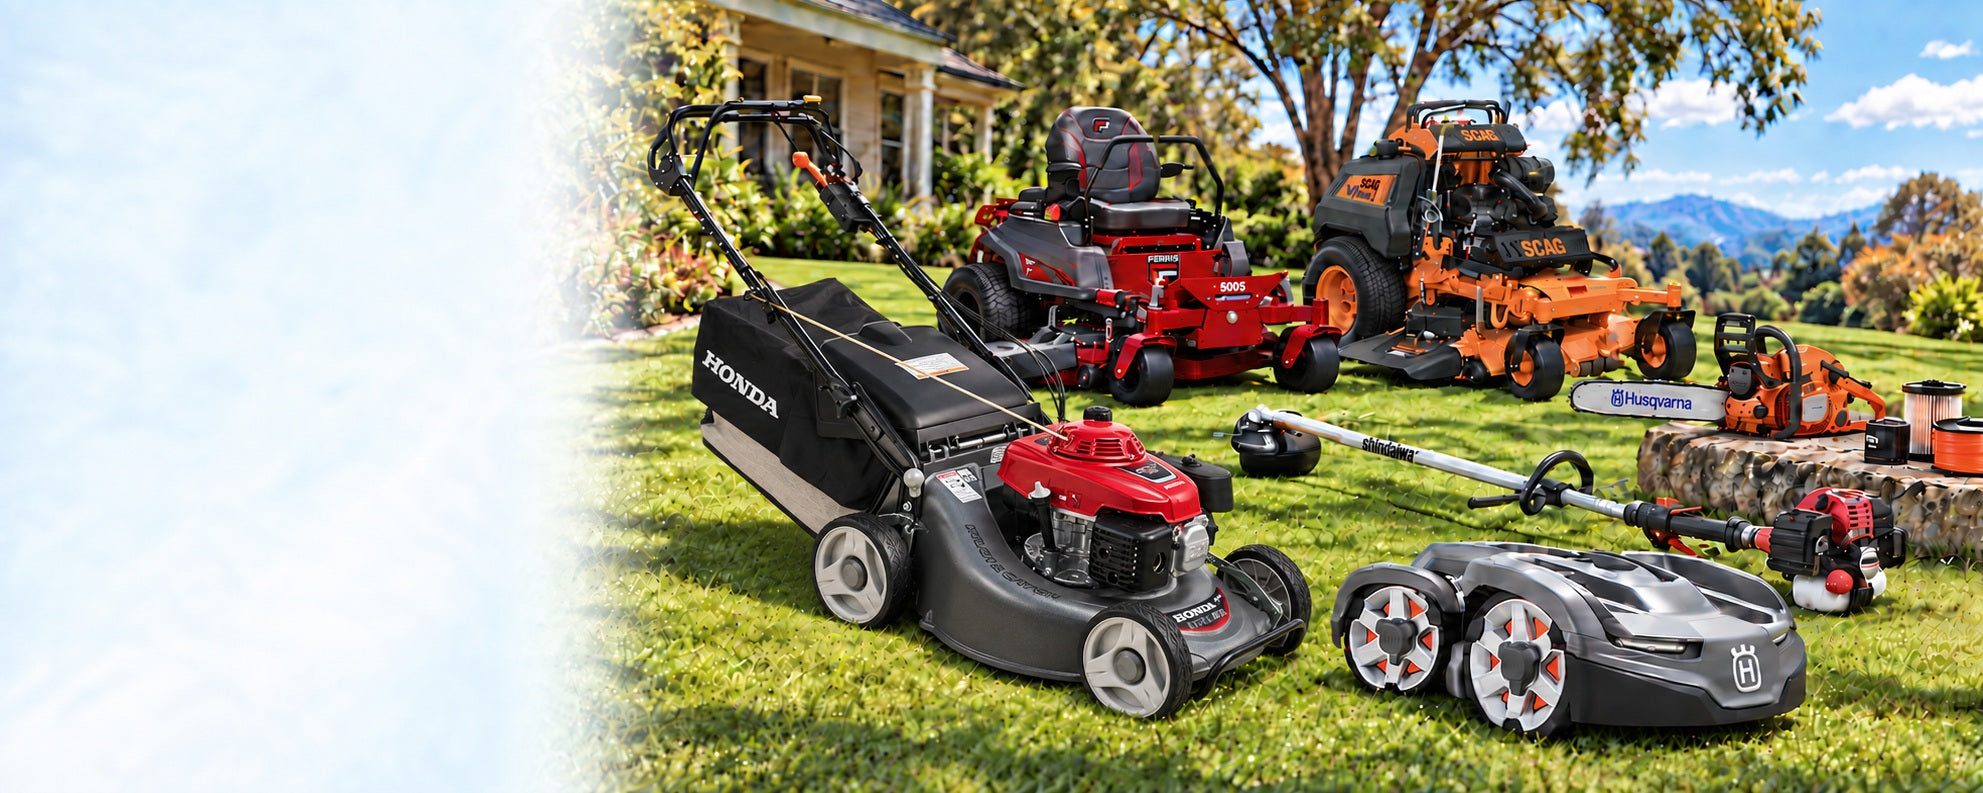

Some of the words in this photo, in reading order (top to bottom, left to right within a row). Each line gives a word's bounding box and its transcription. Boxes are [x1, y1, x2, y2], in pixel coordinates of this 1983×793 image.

[1461, 129, 1499, 141] SCAG
[1360, 178, 1380, 190] SCAG
[1520, 237, 1567, 258] SCAG
[1220, 282, 1246, 292] 500S
[702, 349, 779, 419] HONDA
[1625, 391, 1692, 411] Husqvarna
[1362, 437, 1415, 464] shindaiwa
